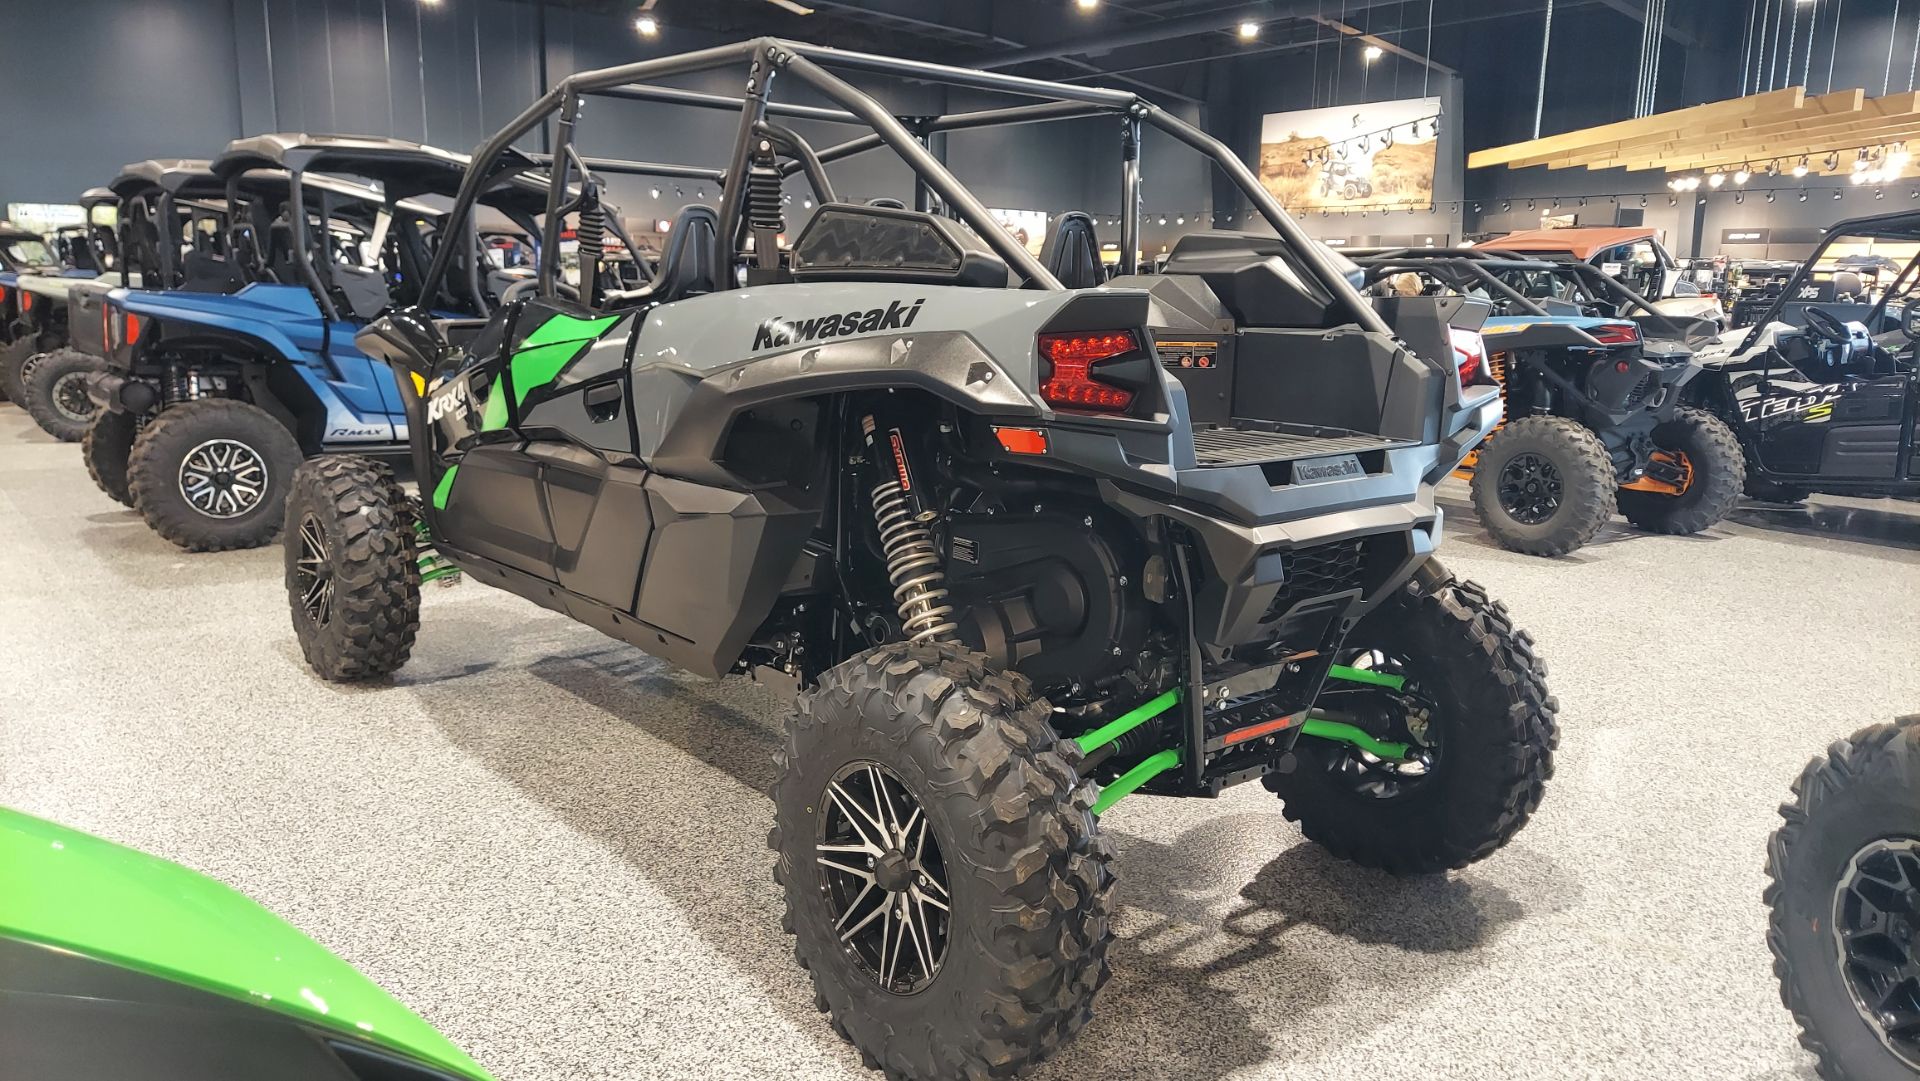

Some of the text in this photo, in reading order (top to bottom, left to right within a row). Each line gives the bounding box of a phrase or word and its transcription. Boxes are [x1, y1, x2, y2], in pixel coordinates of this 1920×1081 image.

[752, 298, 926, 352] Kawasaki
[427, 380, 466, 425] KRX4
[1296, 458, 1360, 481] Kawasaki
